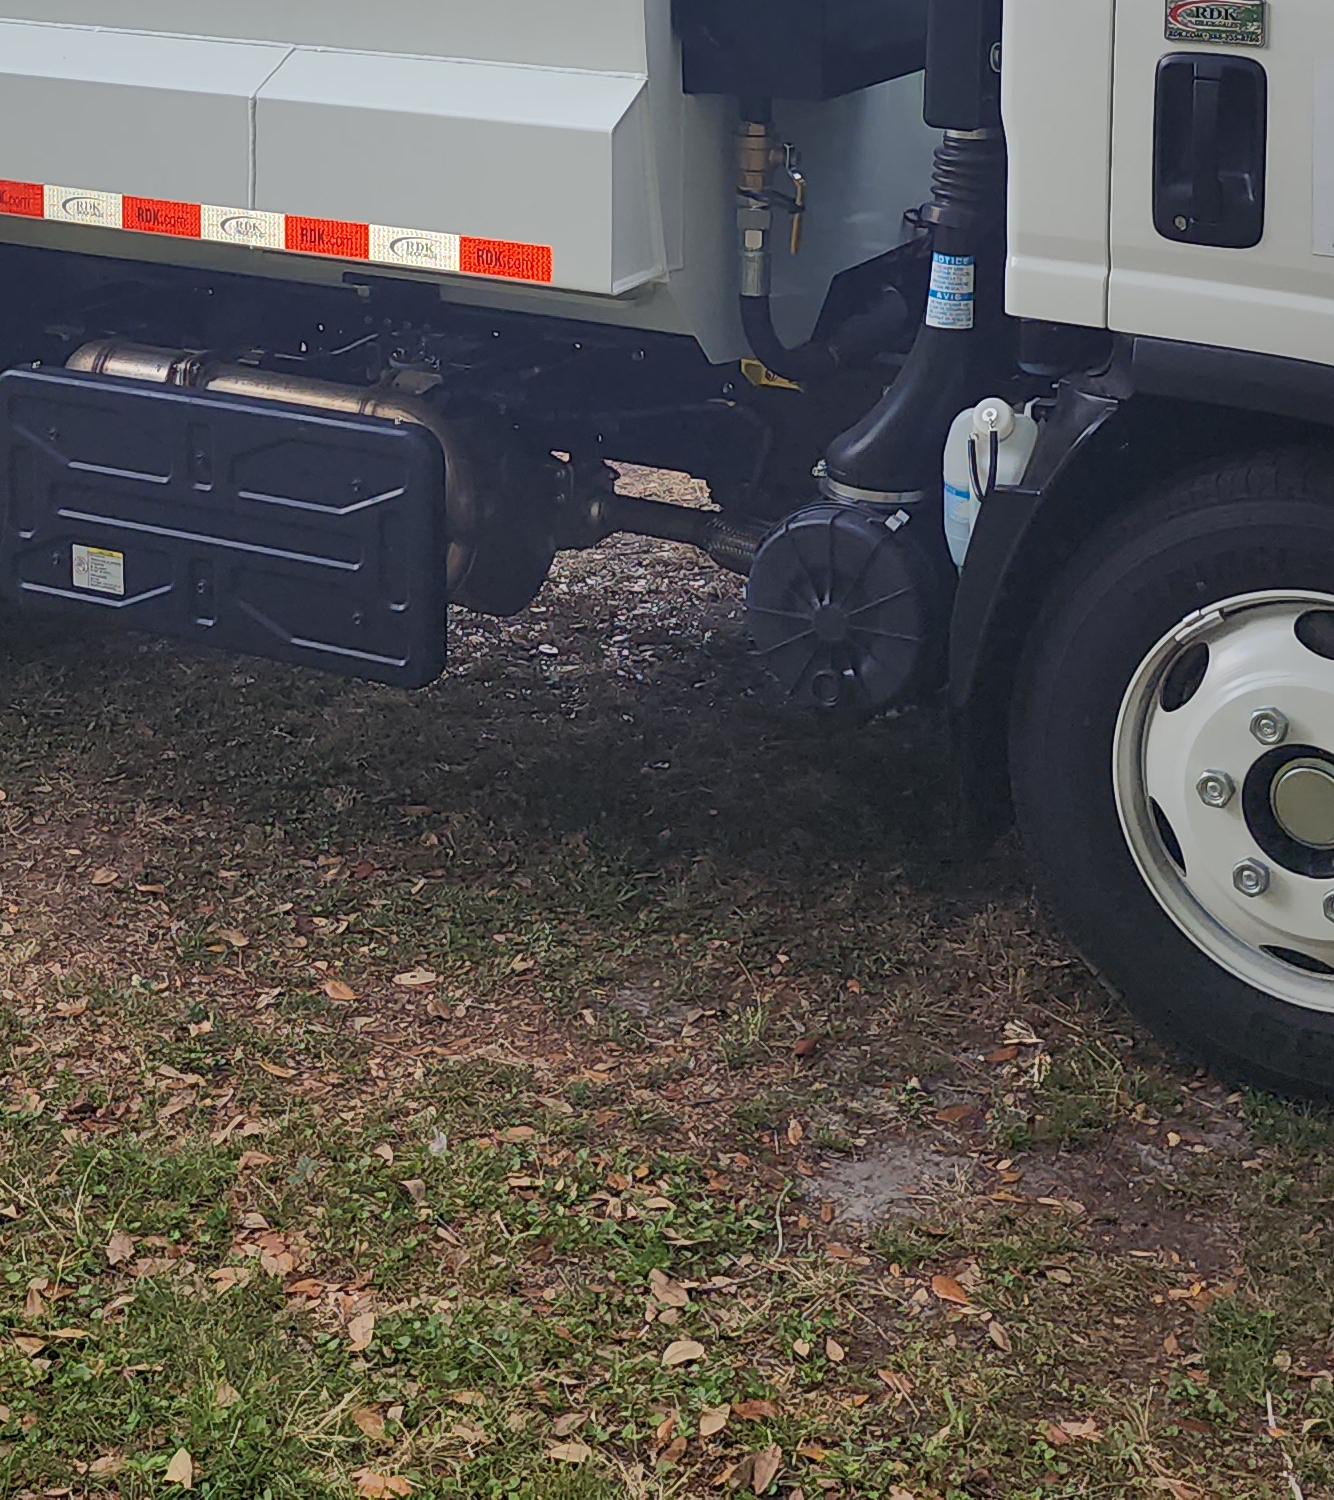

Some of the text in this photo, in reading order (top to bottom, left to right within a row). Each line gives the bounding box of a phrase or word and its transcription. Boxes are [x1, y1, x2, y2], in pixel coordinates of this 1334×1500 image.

[1194, 6, 1238, 21] RDK
[76, 200, 101, 213] RDK
[137, 206, 186, 229] RDK.com
[235, 220, 262, 234] RDK
[300, 227, 354, 249] RDK.com
[405, 240, 434, 254] RDK
[476, 249, 533, 272] RDK.com
